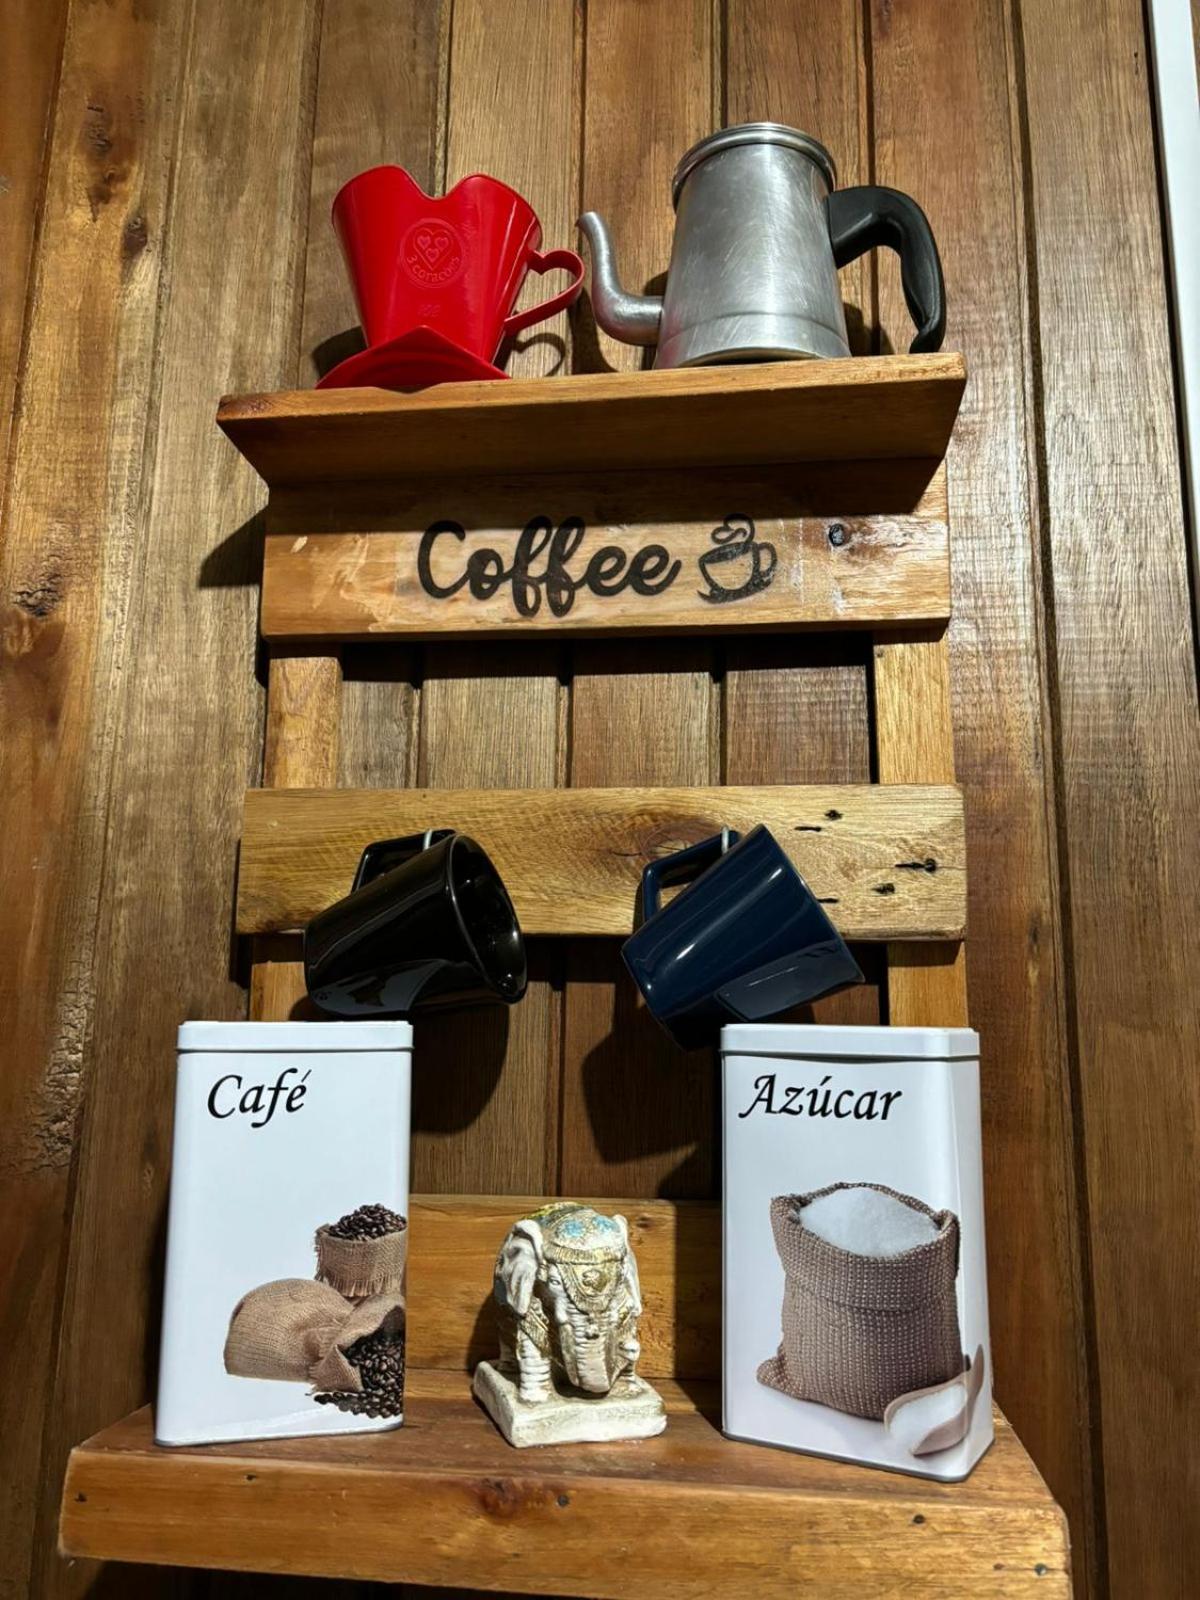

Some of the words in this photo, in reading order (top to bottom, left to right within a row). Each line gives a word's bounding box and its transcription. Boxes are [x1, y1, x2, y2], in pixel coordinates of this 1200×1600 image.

[406, 254, 418, 264] 3
[417, 515, 682, 617] Coffee
[207, 1067, 312, 1128] Café
[738, 1074, 903, 1120] Azúcar
